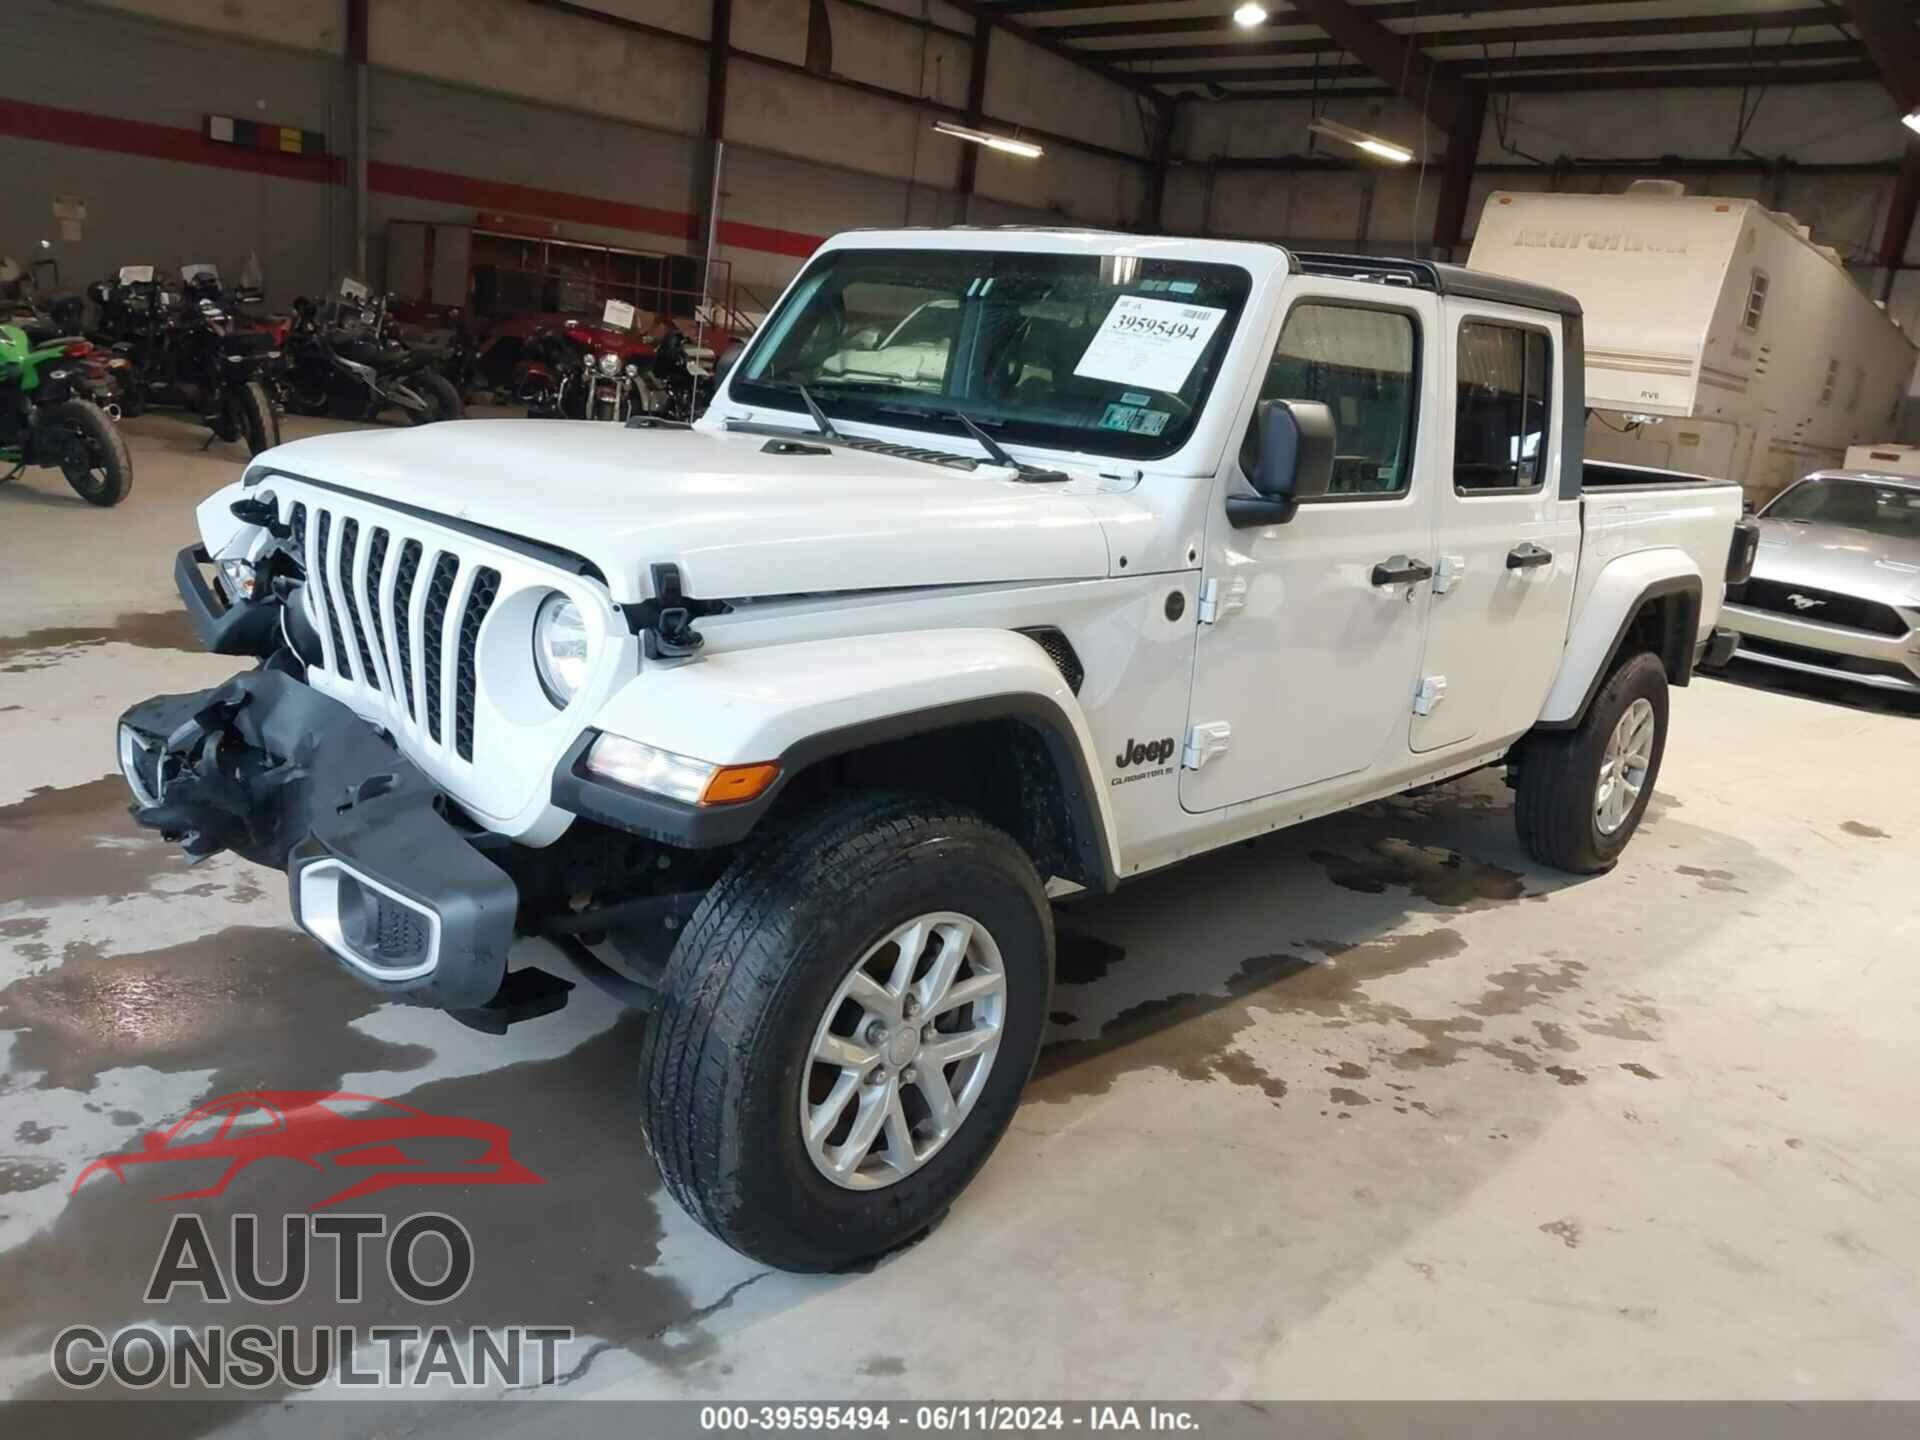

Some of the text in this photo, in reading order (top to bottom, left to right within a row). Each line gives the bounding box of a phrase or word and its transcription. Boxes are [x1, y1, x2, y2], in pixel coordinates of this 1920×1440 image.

[1112, 314, 1199, 340] 39595494
[1115, 737, 1174, 768] Jeep
[1111, 769, 1164, 785] GLADIATOR
